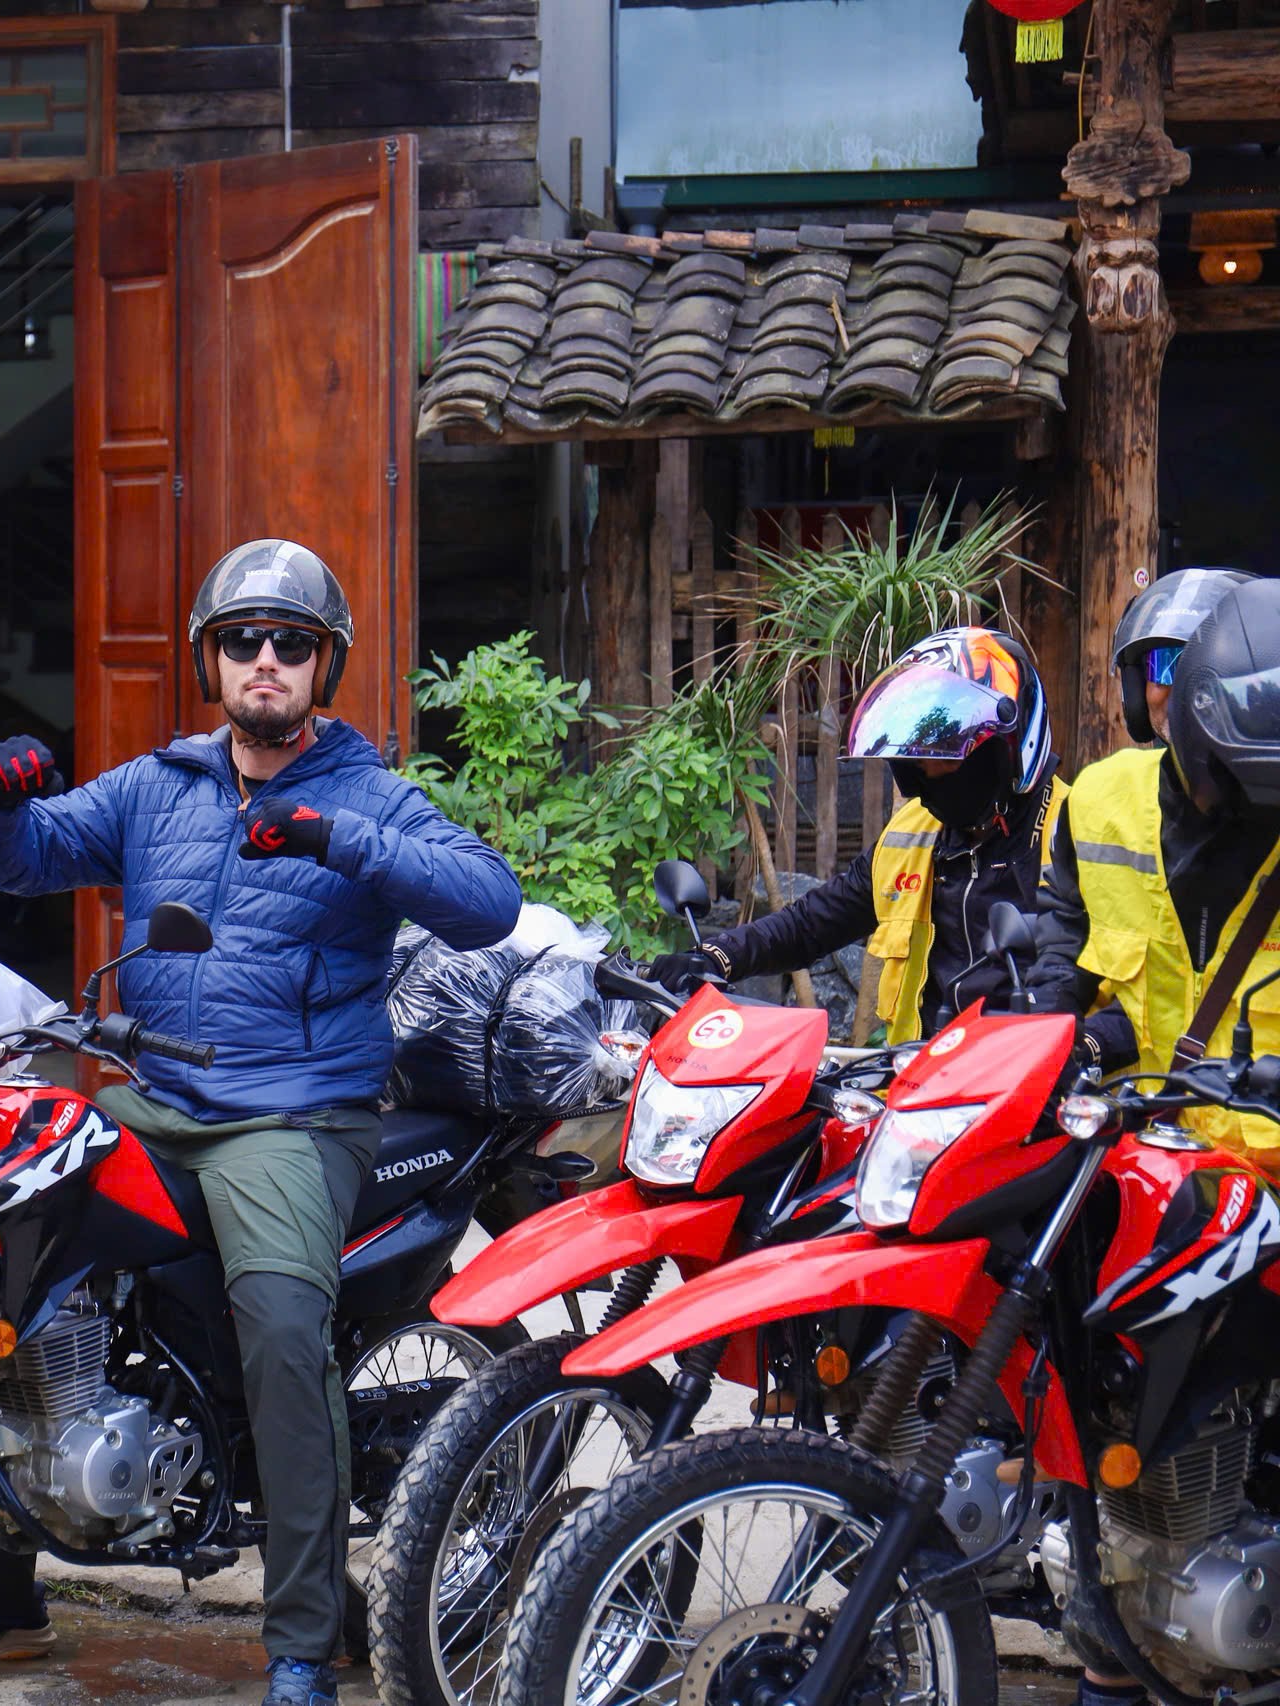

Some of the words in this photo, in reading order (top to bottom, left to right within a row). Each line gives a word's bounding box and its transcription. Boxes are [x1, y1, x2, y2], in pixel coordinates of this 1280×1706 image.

[245, 569, 291, 578] HONDA
[695, 1015, 734, 1039] Go
[374, 1149, 454, 1183] HONDA
[1220, 1178, 1248, 1233] 150L
